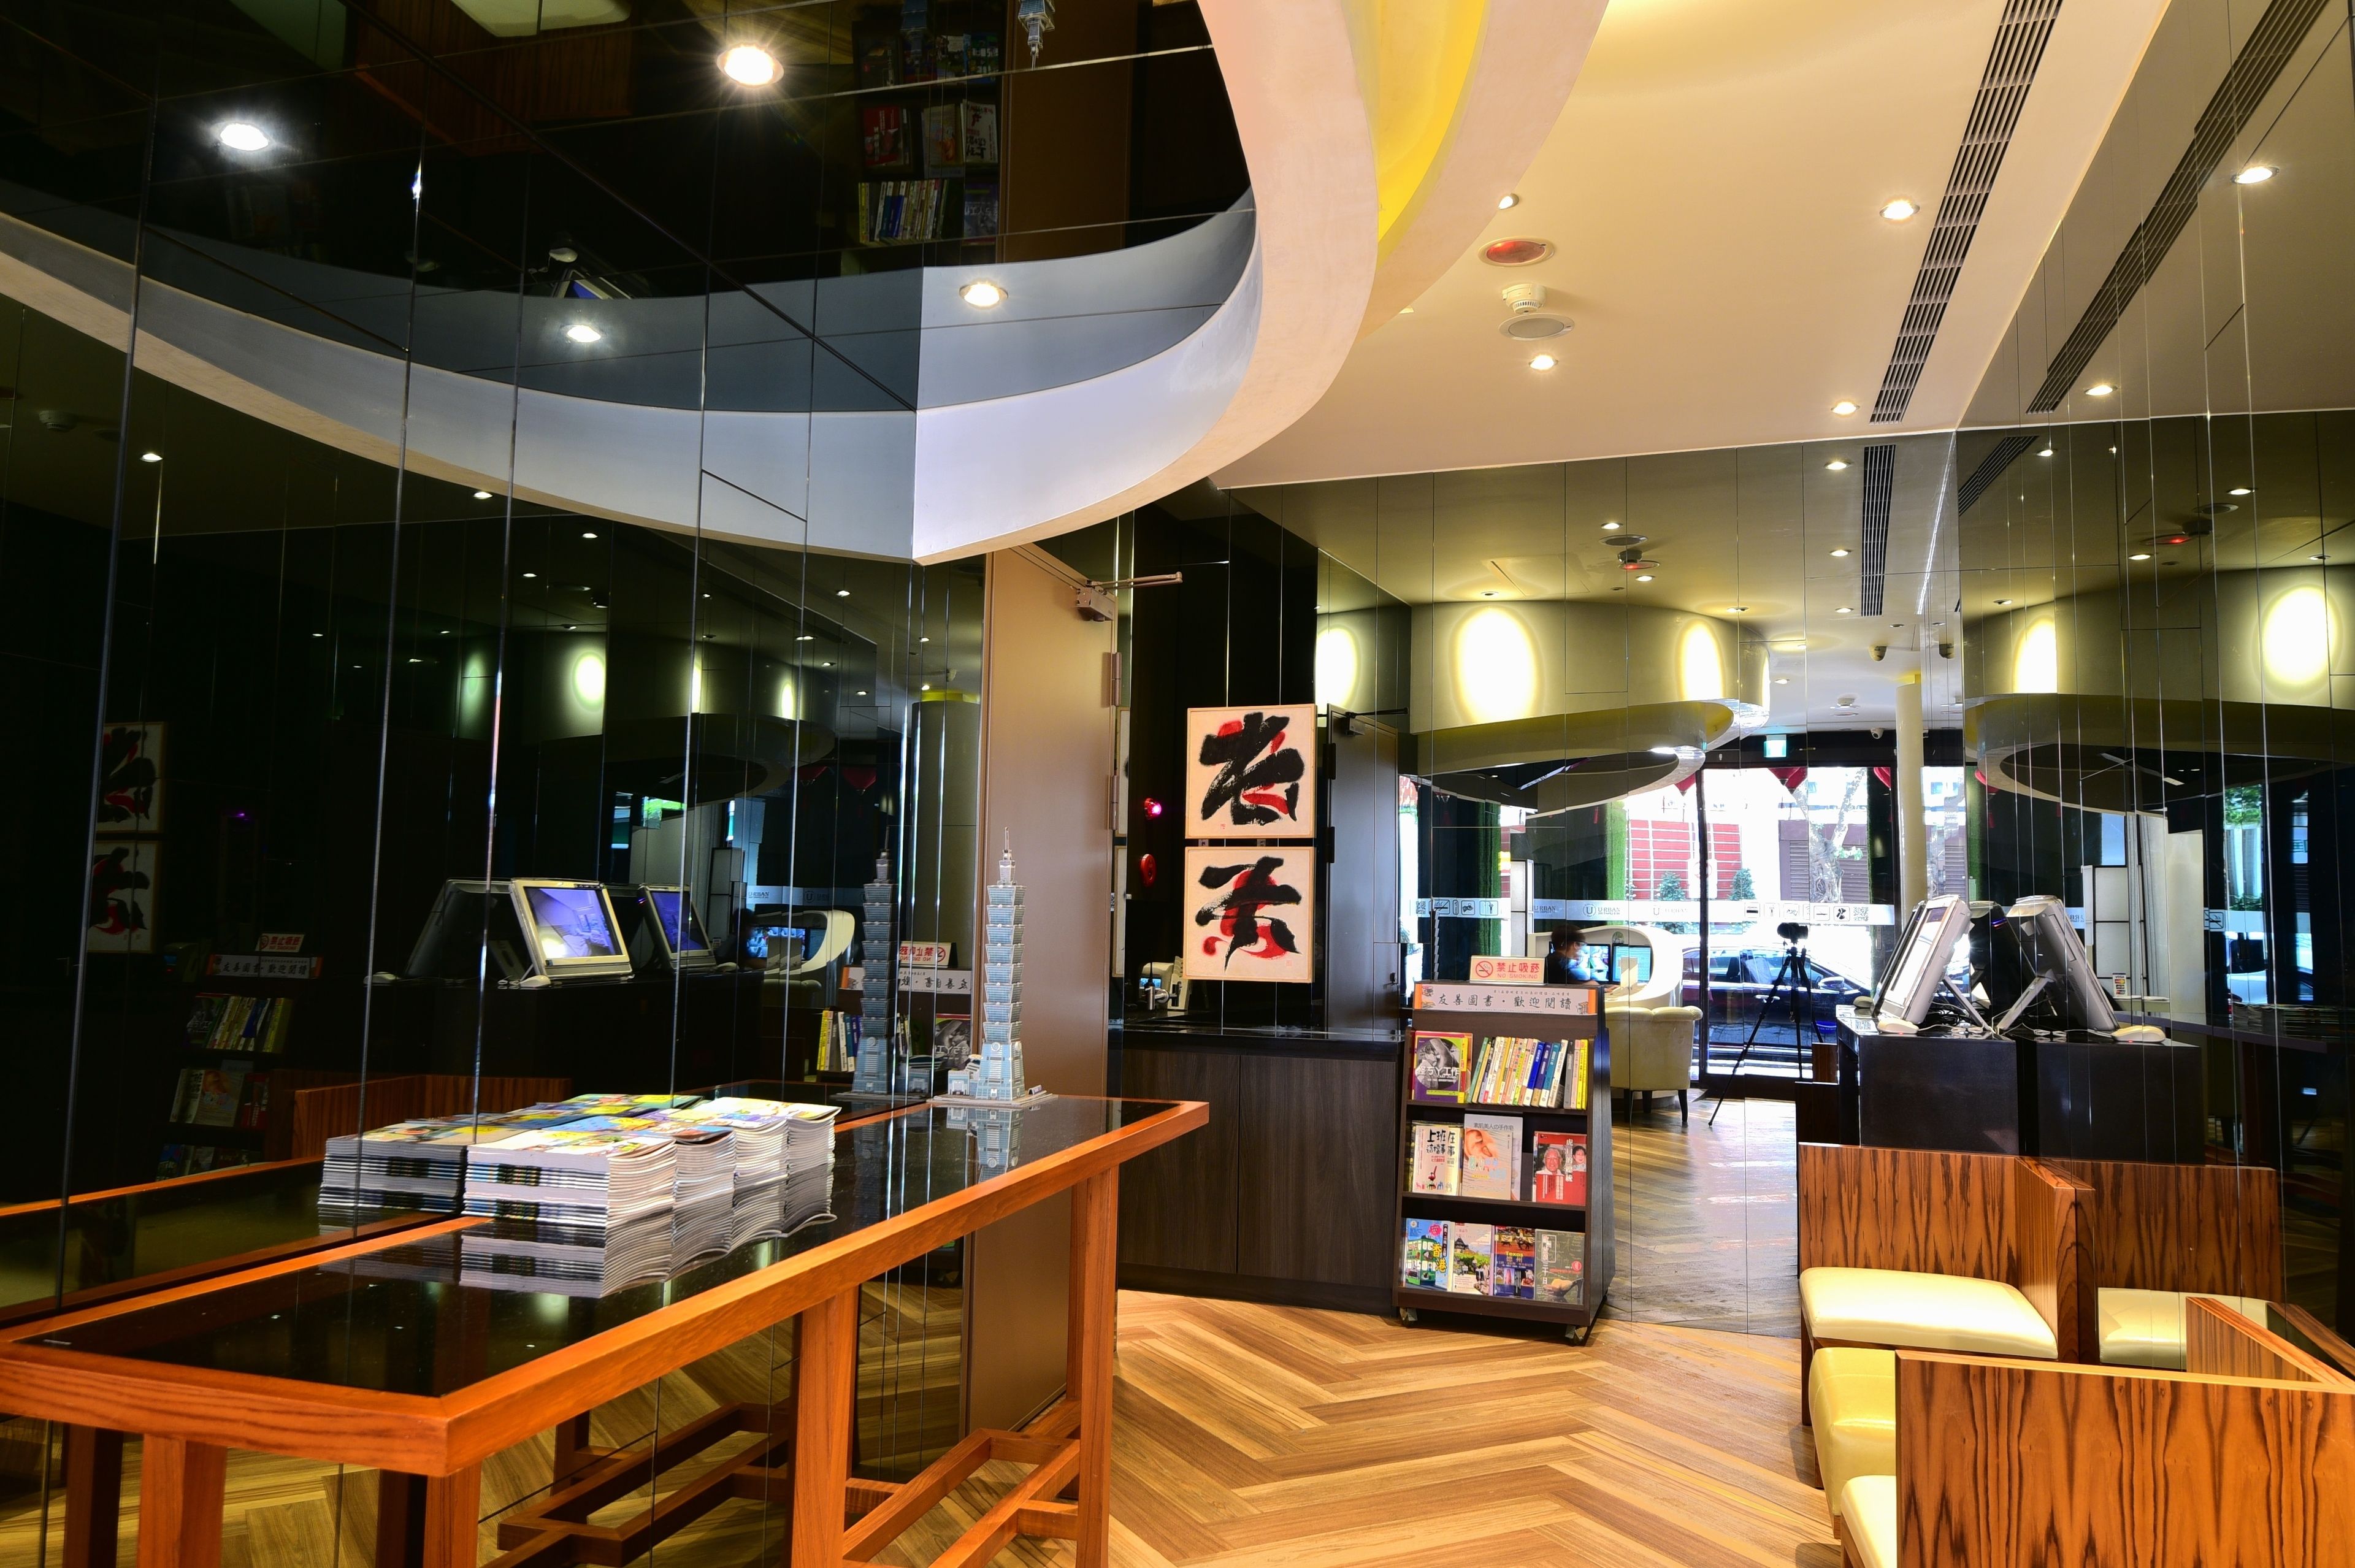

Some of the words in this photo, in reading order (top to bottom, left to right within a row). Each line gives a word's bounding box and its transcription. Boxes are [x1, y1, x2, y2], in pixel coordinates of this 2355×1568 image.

[1496, 962, 1540, 973] 禁止吸菸
[1432, 1243, 1448, 1274] 香港
